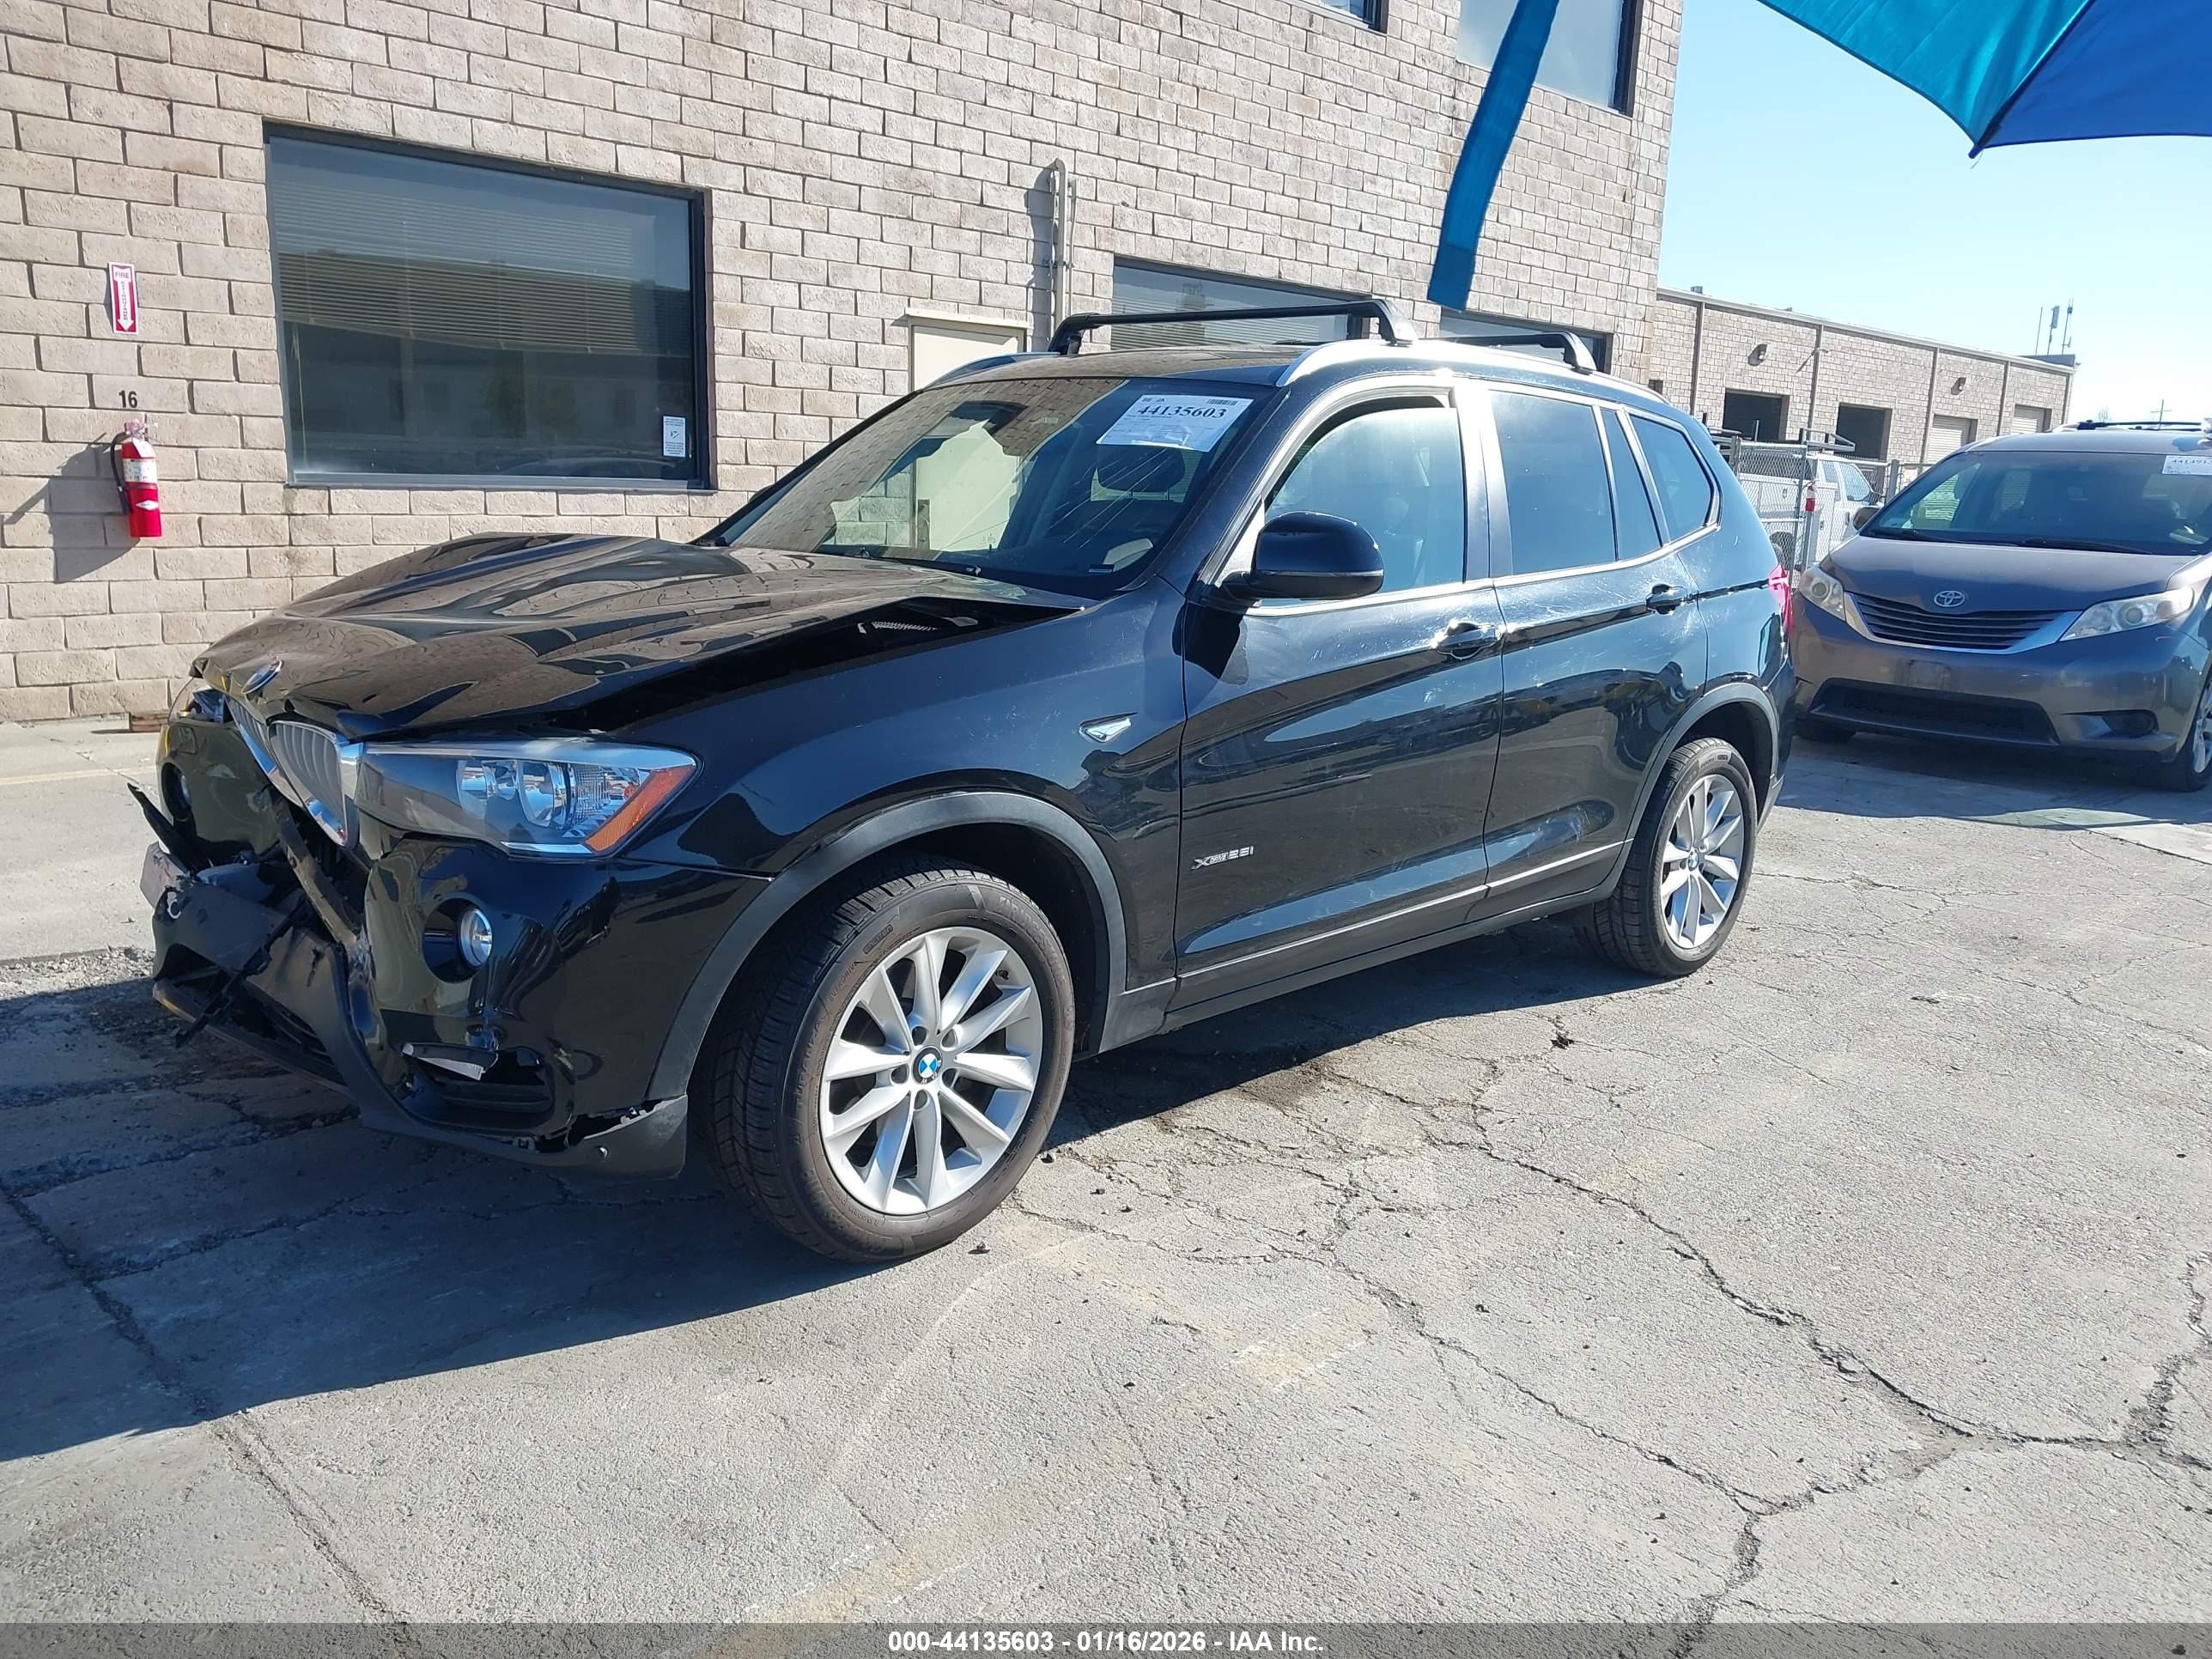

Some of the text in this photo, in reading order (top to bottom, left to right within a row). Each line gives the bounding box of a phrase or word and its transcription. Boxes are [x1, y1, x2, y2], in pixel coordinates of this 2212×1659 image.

[115, 270, 130, 279] FIRE
[118, 390, 138, 408] 16
[1138, 406, 1227, 418] 44135603
